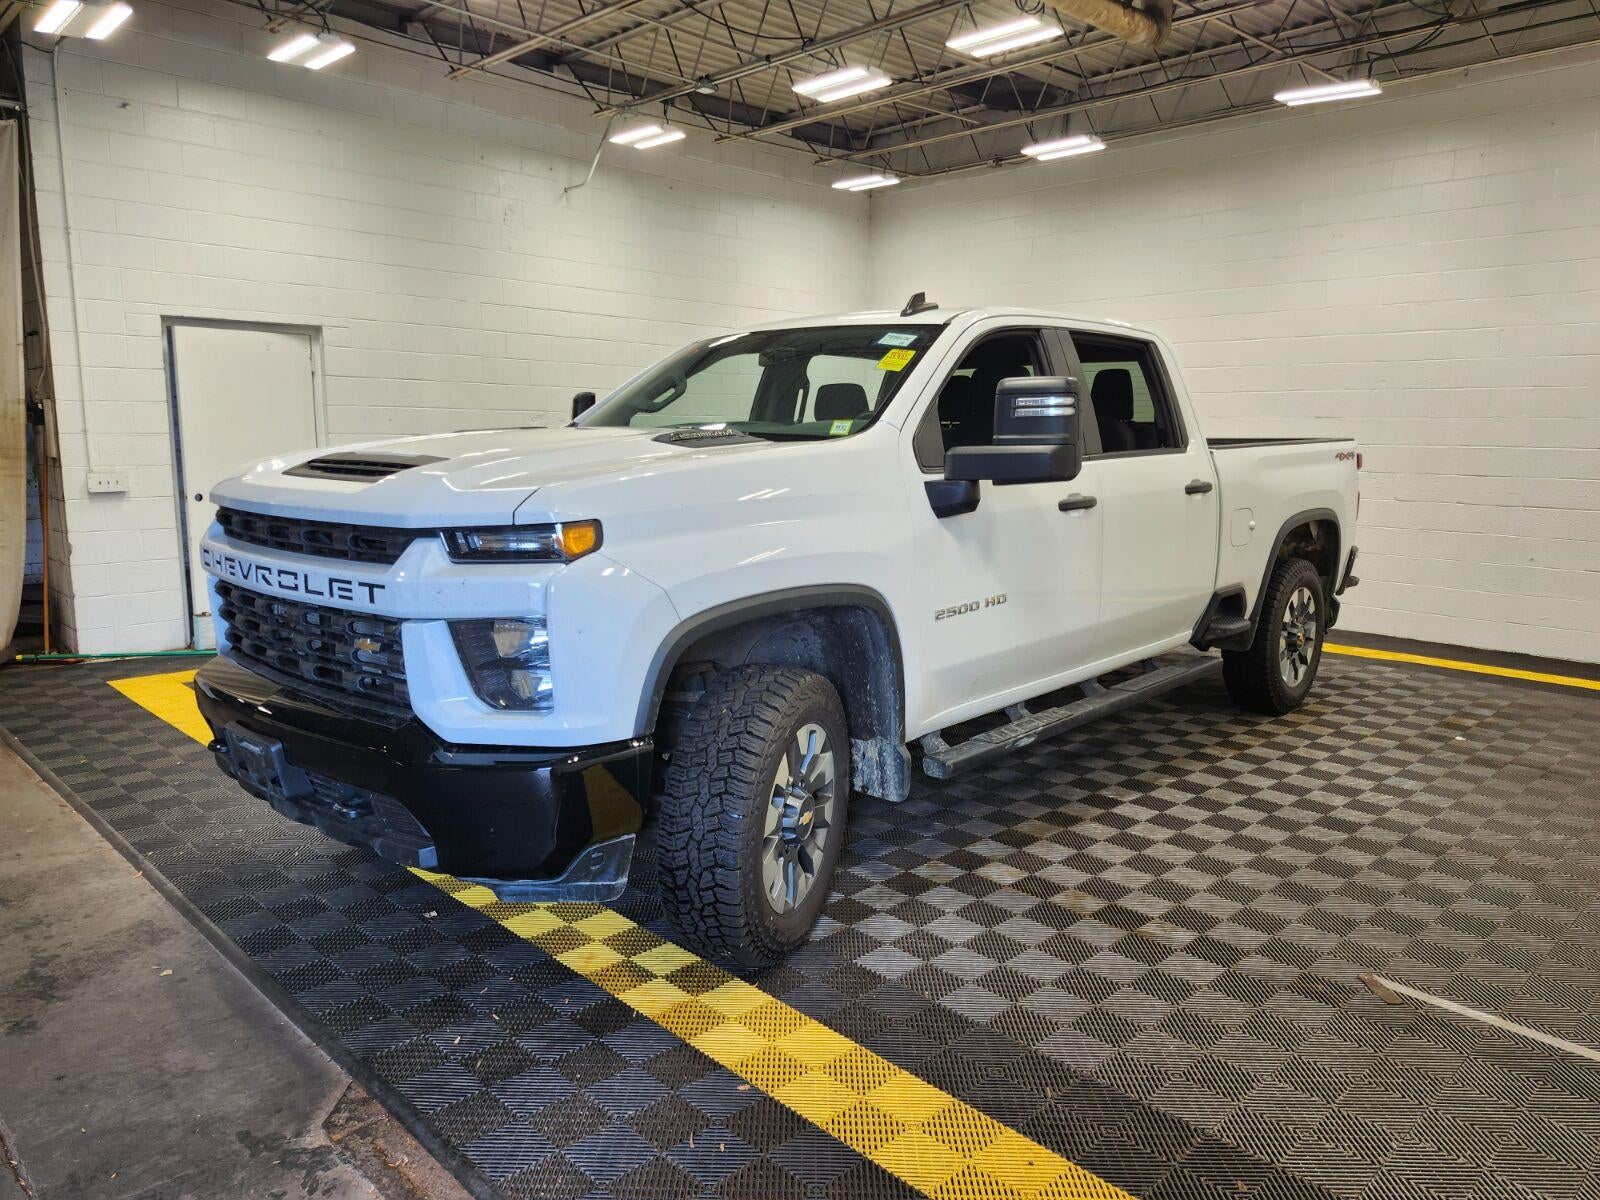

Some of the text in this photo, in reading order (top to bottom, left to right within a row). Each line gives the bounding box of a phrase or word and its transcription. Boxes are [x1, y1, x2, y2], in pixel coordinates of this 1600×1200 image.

[202, 549, 386, 605] CHEVROLET
[934, 593, 1008, 621] 2500 HD
